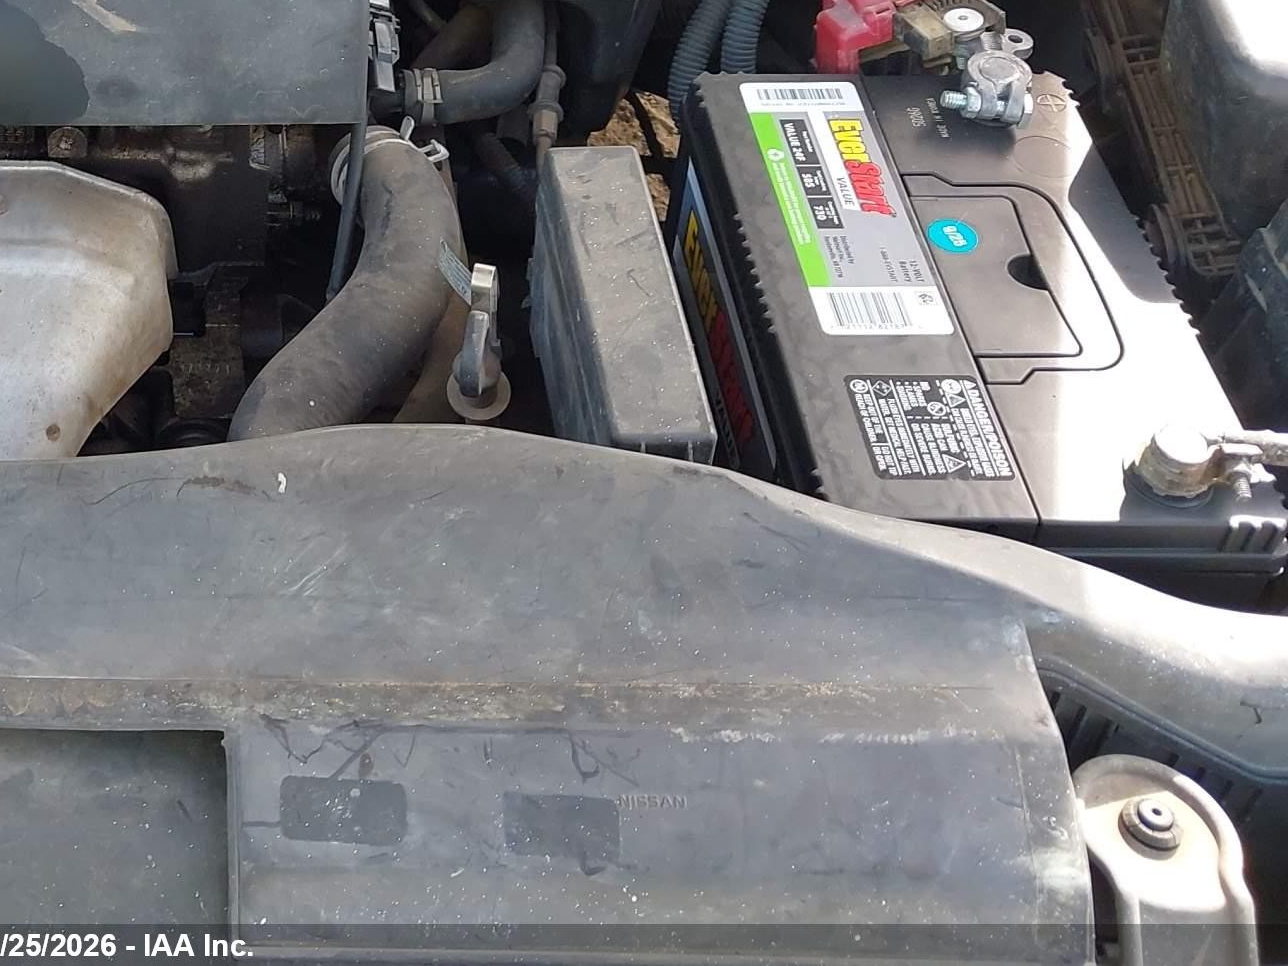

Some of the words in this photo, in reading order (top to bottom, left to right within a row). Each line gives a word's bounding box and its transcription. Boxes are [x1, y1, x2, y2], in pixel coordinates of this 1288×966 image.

[782, 122, 802, 146] VALUE
[826, 118, 898, 214] EverStart
[834, 177, 855, 206] VALUE
[897, 261, 913, 282] Battery
[908, 260, 924, 281] 12-VOLT
[966, 389, 1012, 475] DANGER/POISON
[617, 794, 688, 810] NISSAN
